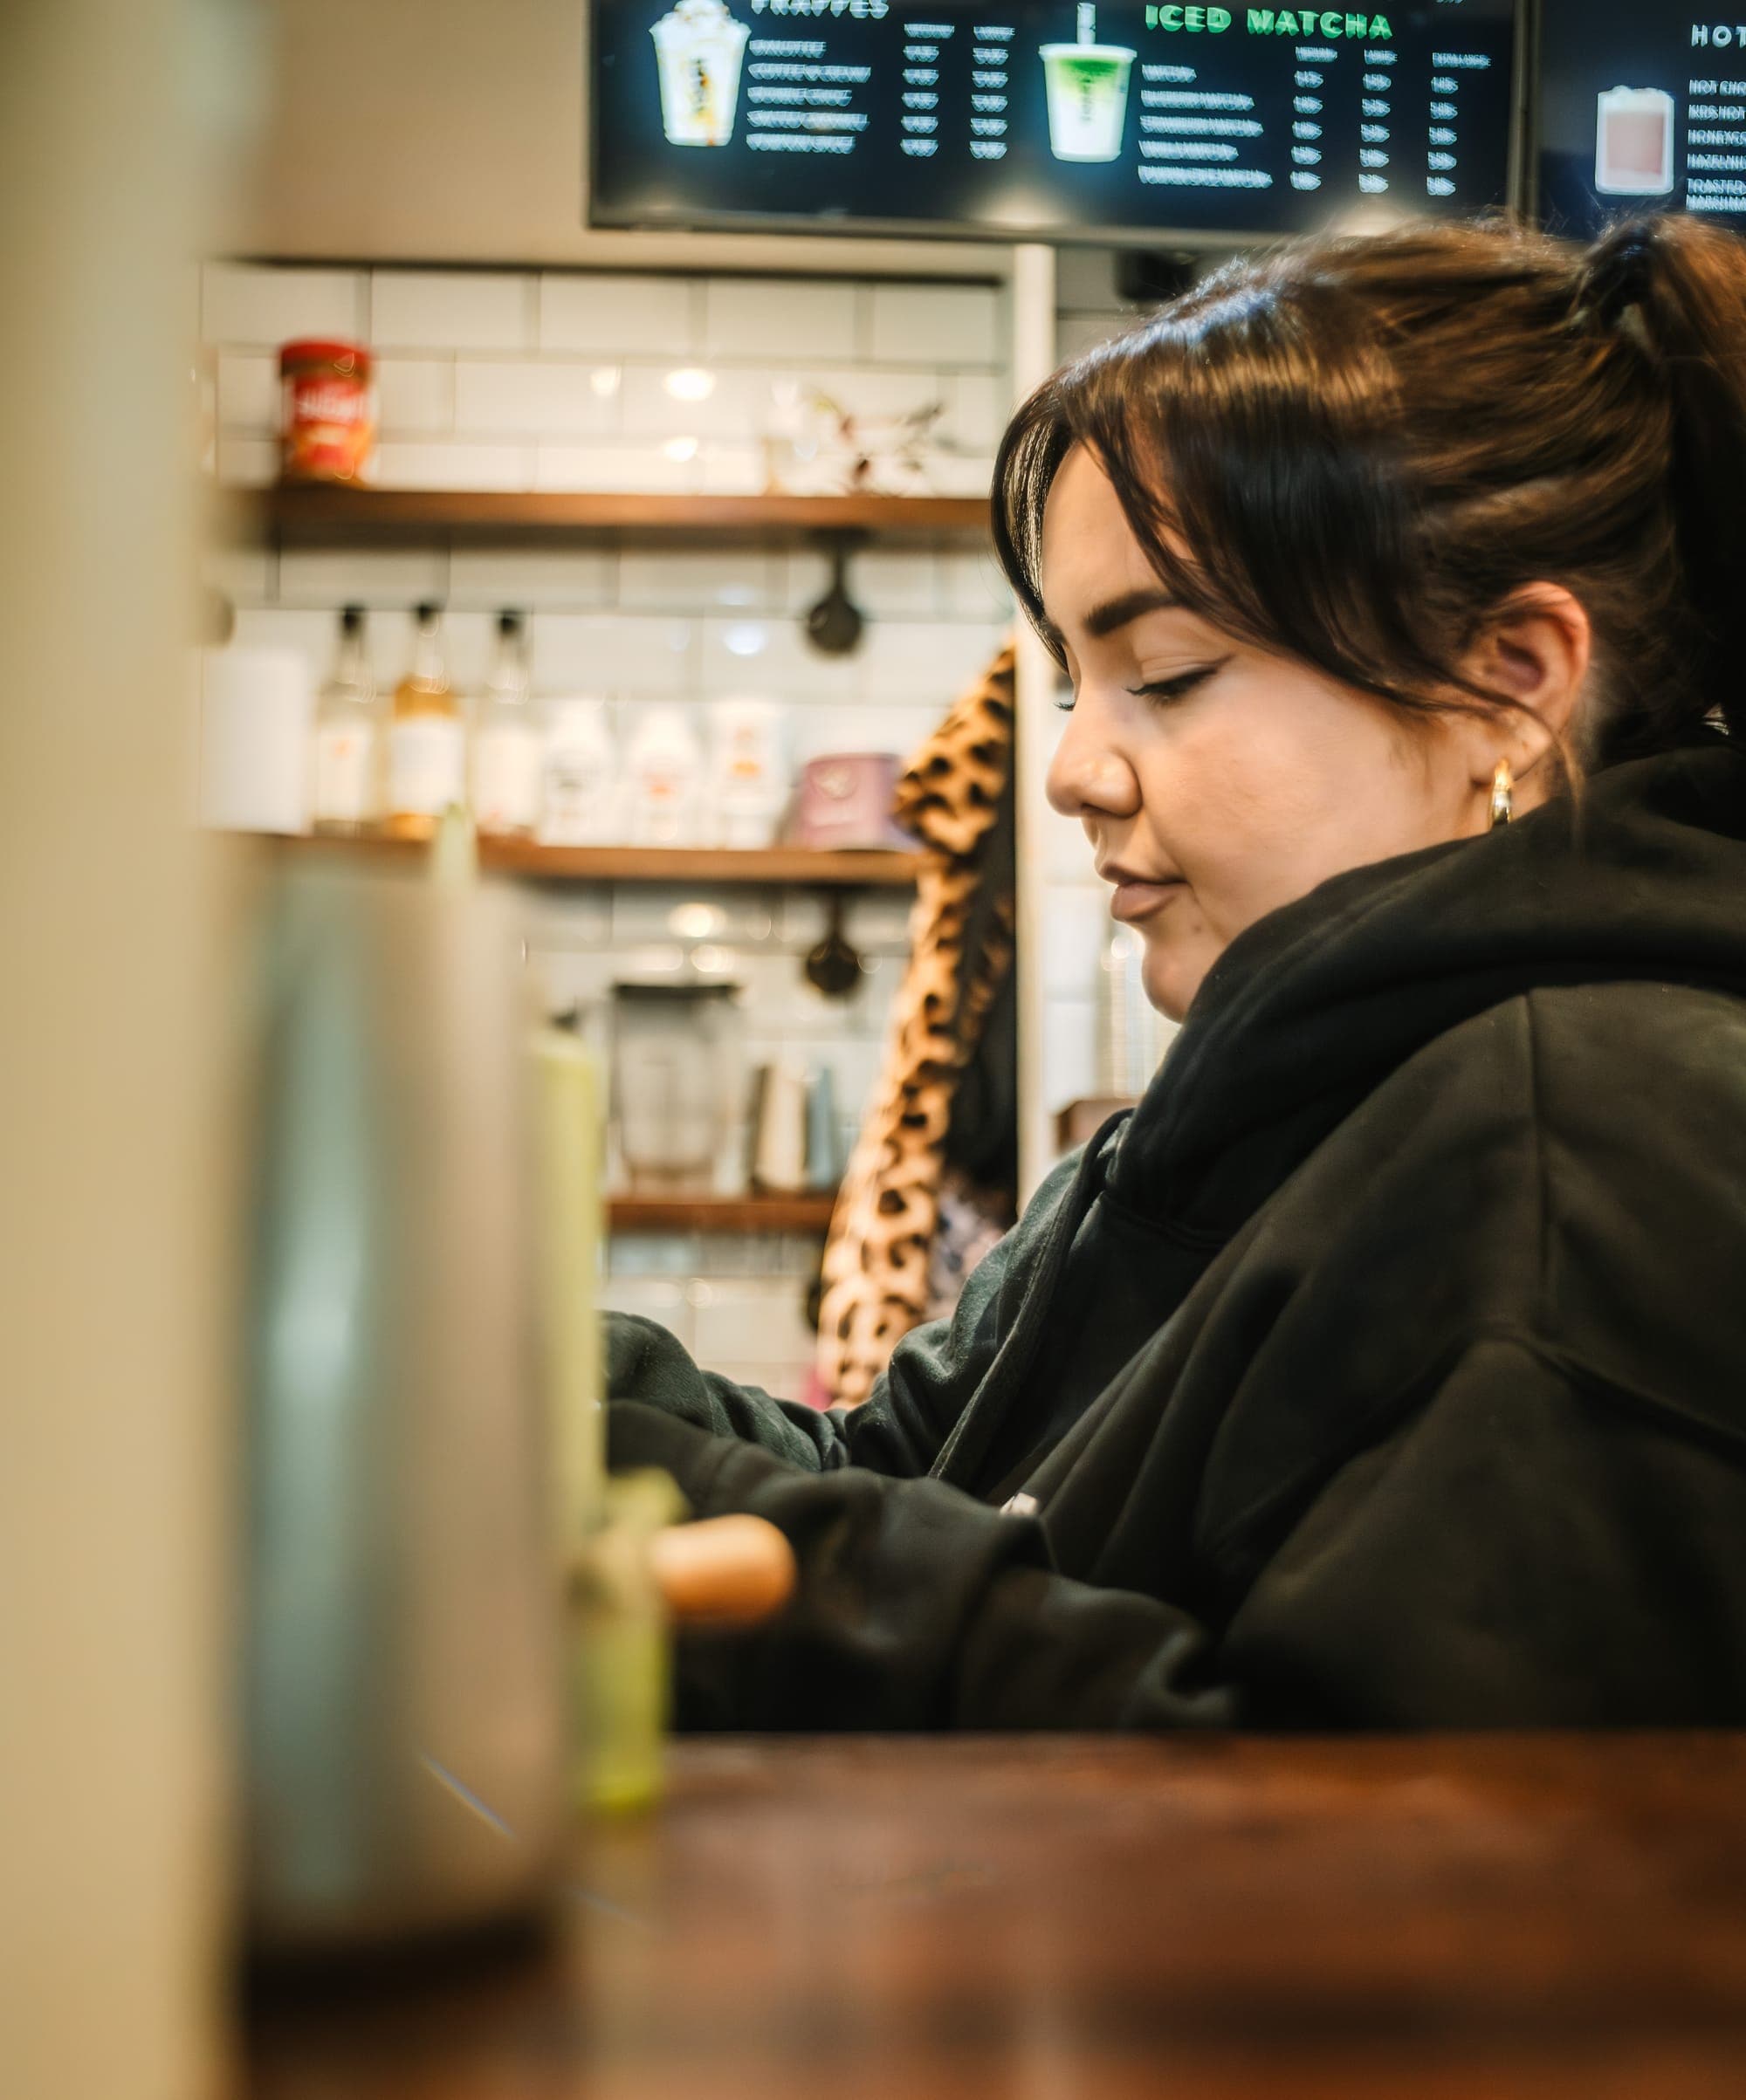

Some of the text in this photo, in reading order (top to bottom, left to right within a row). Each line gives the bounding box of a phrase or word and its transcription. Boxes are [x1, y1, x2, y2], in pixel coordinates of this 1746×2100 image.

[1145, 4, 1393, 40] ICED MATCHA
[1691, 24, 1746, 48] HOT
[1459, 54, 1491, 69] LARGE
[1689, 79, 1718, 95] HOT
[1687, 178, 1746, 195] TOASTED
